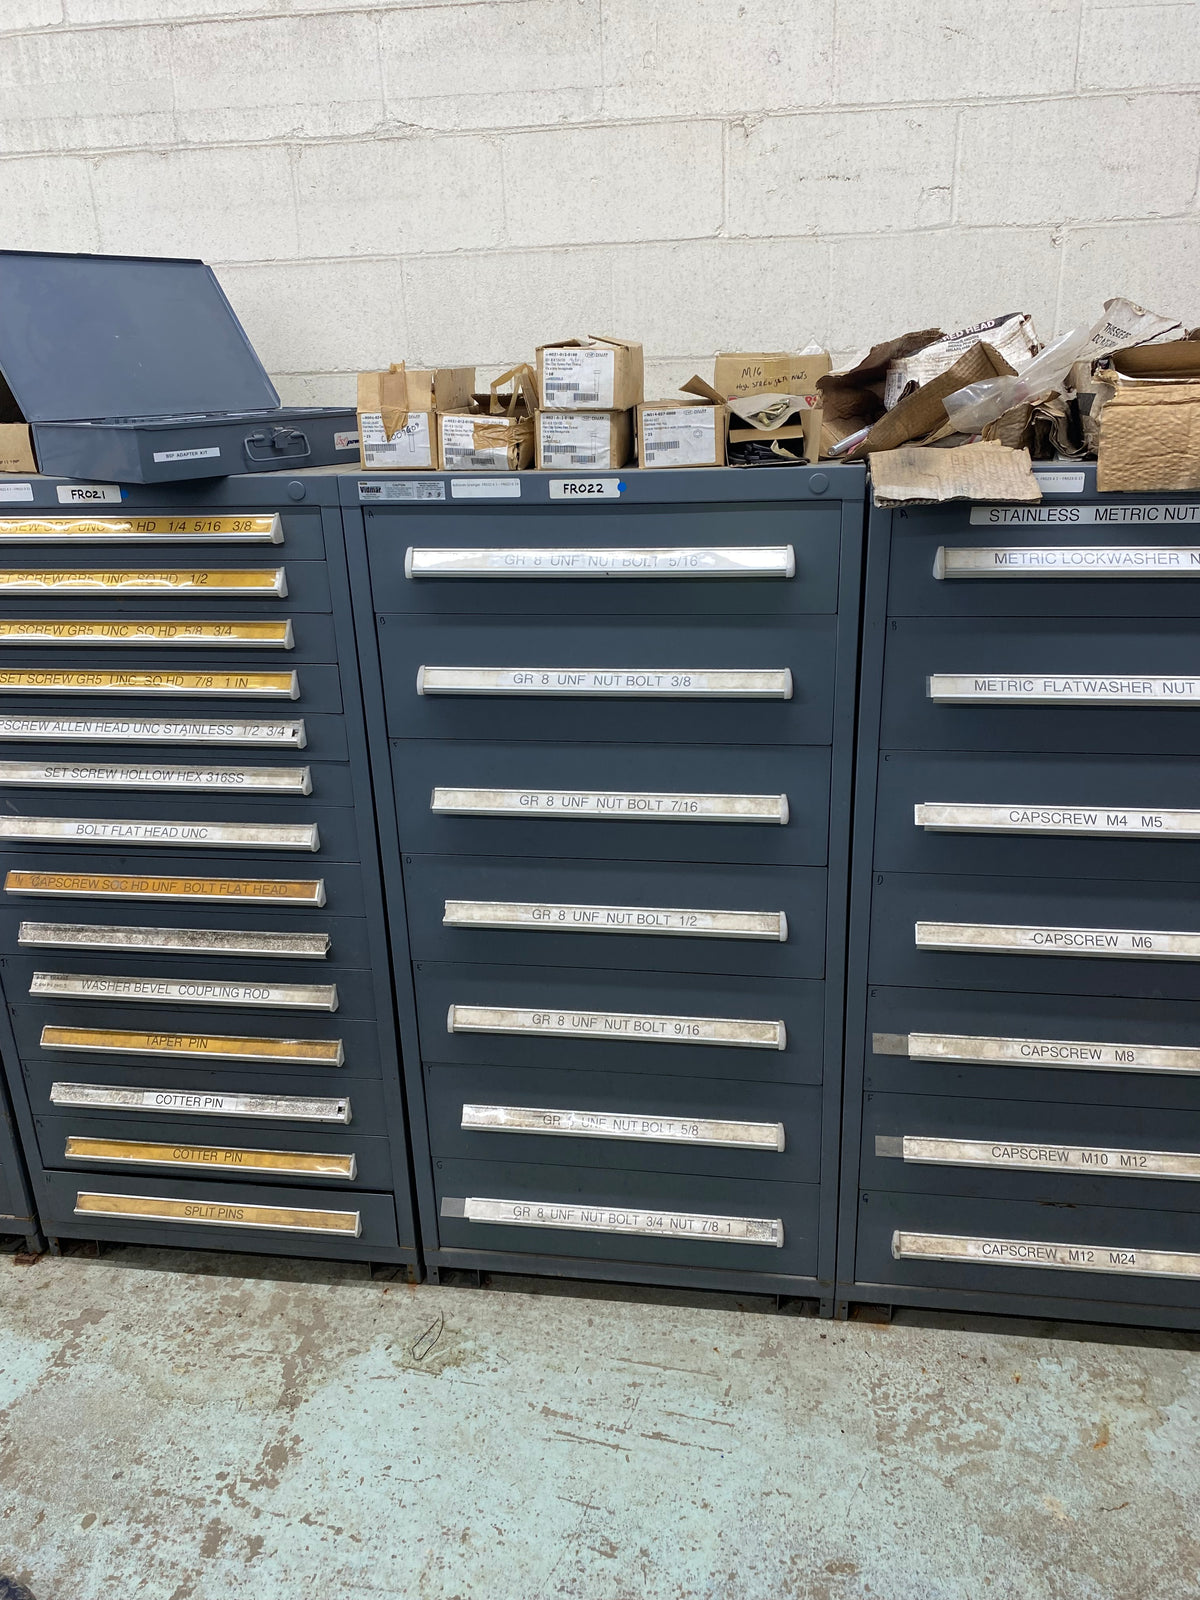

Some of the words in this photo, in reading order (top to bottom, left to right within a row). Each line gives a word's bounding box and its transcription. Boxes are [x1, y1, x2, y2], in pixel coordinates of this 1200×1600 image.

[966, 320, 995, 334] HEAD
[71, 489, 106, 500] FR021
[562, 483, 604, 494] FR022
[989, 509, 1080, 523] STAINLESS
[1094, 507, 1159, 521] METRIC
[1164, 507, 1199, 520] NUT
[78, 522, 105, 532] UNC
[137, 521, 156, 532] HD
[169, 521, 186, 532] 1/4
[194, 521, 221, 532] 5/16
[232, 521, 252, 532] 3/8
[534, 556, 541, 565] 8
[550, 555, 580, 566] UNF
[622, 556, 658, 567] BOLT
[669, 556, 698, 567] 5/16
[993, 552, 1057, 565] METRIC
[1061, 552, 1180, 565] LOCKWASHER
[17, 574, 64, 584] SCREW
[102, 574, 129, 584] UNC
[159, 574, 178, 584] HD
[191, 573, 208, 584] 1/2
[17, 625, 65, 635] SCREW
[68, 625, 94, 636] GR5
[102, 626, 129, 636] UNC
[136, 625, 155, 636] SQ
[158, 626, 177, 637] HD
[184, 626, 202, 636] 5/8
[213, 626, 232, 636] 3/4
[0, 673, 24, 683] SET
[27, 673, 73, 684] SCREW
[77, 674, 102, 685] GR5
[110, 675, 137, 686] UNC
[144, 675, 163, 686] SQ
[166, 676, 184, 687] HD
[196, 677, 213, 687] 7/8
[225, 678, 230, 688] 1
[234, 678, 249, 688] IN
[513, 673, 534, 684] GR
[541, 674, 549, 685] 8
[557, 674, 586, 686] UNF
[593, 675, 622, 686] NUT
[626, 675, 661, 687] BOLT
[671, 676, 691, 687] 3/8
[974, 680, 1034, 692] METRIC
[1043, 681, 1153, 694] FLATWASHER
[1162, 682, 1195, 694] NUT
[52, 722, 92, 732] ALLEN
[95, 722, 130, 733] HEAD
[133, 723, 161, 733] UNC
[164, 724, 234, 735] STAINLESS
[242, 726, 259, 736] 1/2
[266, 726, 285, 736] 3/4
[45, 767, 69, 778] SET
[71, 768, 117, 779] SCREW
[121, 769, 174, 781] HOLLOW
[177, 771, 202, 782] HEX
[206, 772, 244, 783] 316SS
[520, 795, 540, 806] GR
[546, 796, 554, 806] 8
[562, 797, 589, 808] UNF
[596, 797, 624, 809] NUT
[628, 799, 663, 811] BOLT
[671, 800, 698, 812] 7/16
[1009, 810, 1097, 825] CAPSCREW
[1106, 815, 1128, 826] M4
[1141, 816, 1163, 828] M5
[77, 825, 109, 836] BOLT
[111, 826, 141, 837] FLAT
[144, 826, 179, 838] HEAD
[181, 828, 208, 839] UNC
[31, 875, 99, 889] CAPSCREW
[102, 879, 128, 891] SOC
[131, 880, 149, 891] HD
[151, 881, 177, 892] UNF
[184, 882, 217, 894] BOLT
[219, 883, 249, 895] FLAT
[253, 884, 287, 896] HEAD
[532, 909, 551, 921] GR
[558, 910, 566, 921] 8
[573, 911, 599, 923] UNF
[606, 912, 633, 924] NUT
[636, 913, 670, 925] BOLT
[679, 914, 698, 926] 1/2
[1033, 933, 1118, 947] CAPSCREW
[1131, 937, 1152, 948] M6
[81, 979, 131, 992] WASHER
[134, 982, 171, 994] BEVEL
[178, 985, 240, 999] COUPLING
[243, 988, 270, 999] ROD
[531, 1014, 551, 1025] GR
[557, 1015, 565, 1026] 8
[572, 1016, 598, 1028] UNF
[604, 1018, 631, 1030] NUT
[633, 1020, 666, 1032] BOLT
[674, 1022, 700, 1036] 9/16
[145, 1035, 182, 1047] TAPER
[189, 1037, 208, 1049] PIN
[1020, 1045, 1102, 1060] CAPSCREW
[1115, 1050, 1135, 1062] M8
[155, 1094, 201, 1106] COTTER
[204, 1097, 223, 1108] PIN
[543, 1114, 561, 1125] GR
[581, 1117, 606, 1129] UNF
[613, 1120, 638, 1132] NUT
[641, 1122, 673, 1134] BOLT
[681, 1124, 699, 1136] 5/8
[172, 1148, 217, 1161] COTTER
[224, 1152, 242, 1163] PIN
[992, 1147, 1069, 1162] CAPSCREW
[1082, 1153, 1108, 1165] M10
[1120, 1155, 1147, 1168] M12
[184, 1206, 214, 1218] SPLIT
[218, 1208, 244, 1219] PINS
[513, 1206, 531, 1217] GR
[537, 1208, 544, 1219] 8
[550, 1209, 575, 1221] UNF
[581, 1211, 606, 1223] NUT
[609, 1213, 638, 1226] BOLT
[646, 1216, 663, 1228] 3/4
[670, 1218, 695, 1231] NUT
[701, 1220, 719, 1232] 7/8
[727, 1222, 732, 1233] 1
[982, 1244, 1057, 1260] CAPSCREW
[1068, 1251, 1094, 1262] M12
[1109, 1253, 1136, 1265] M24
